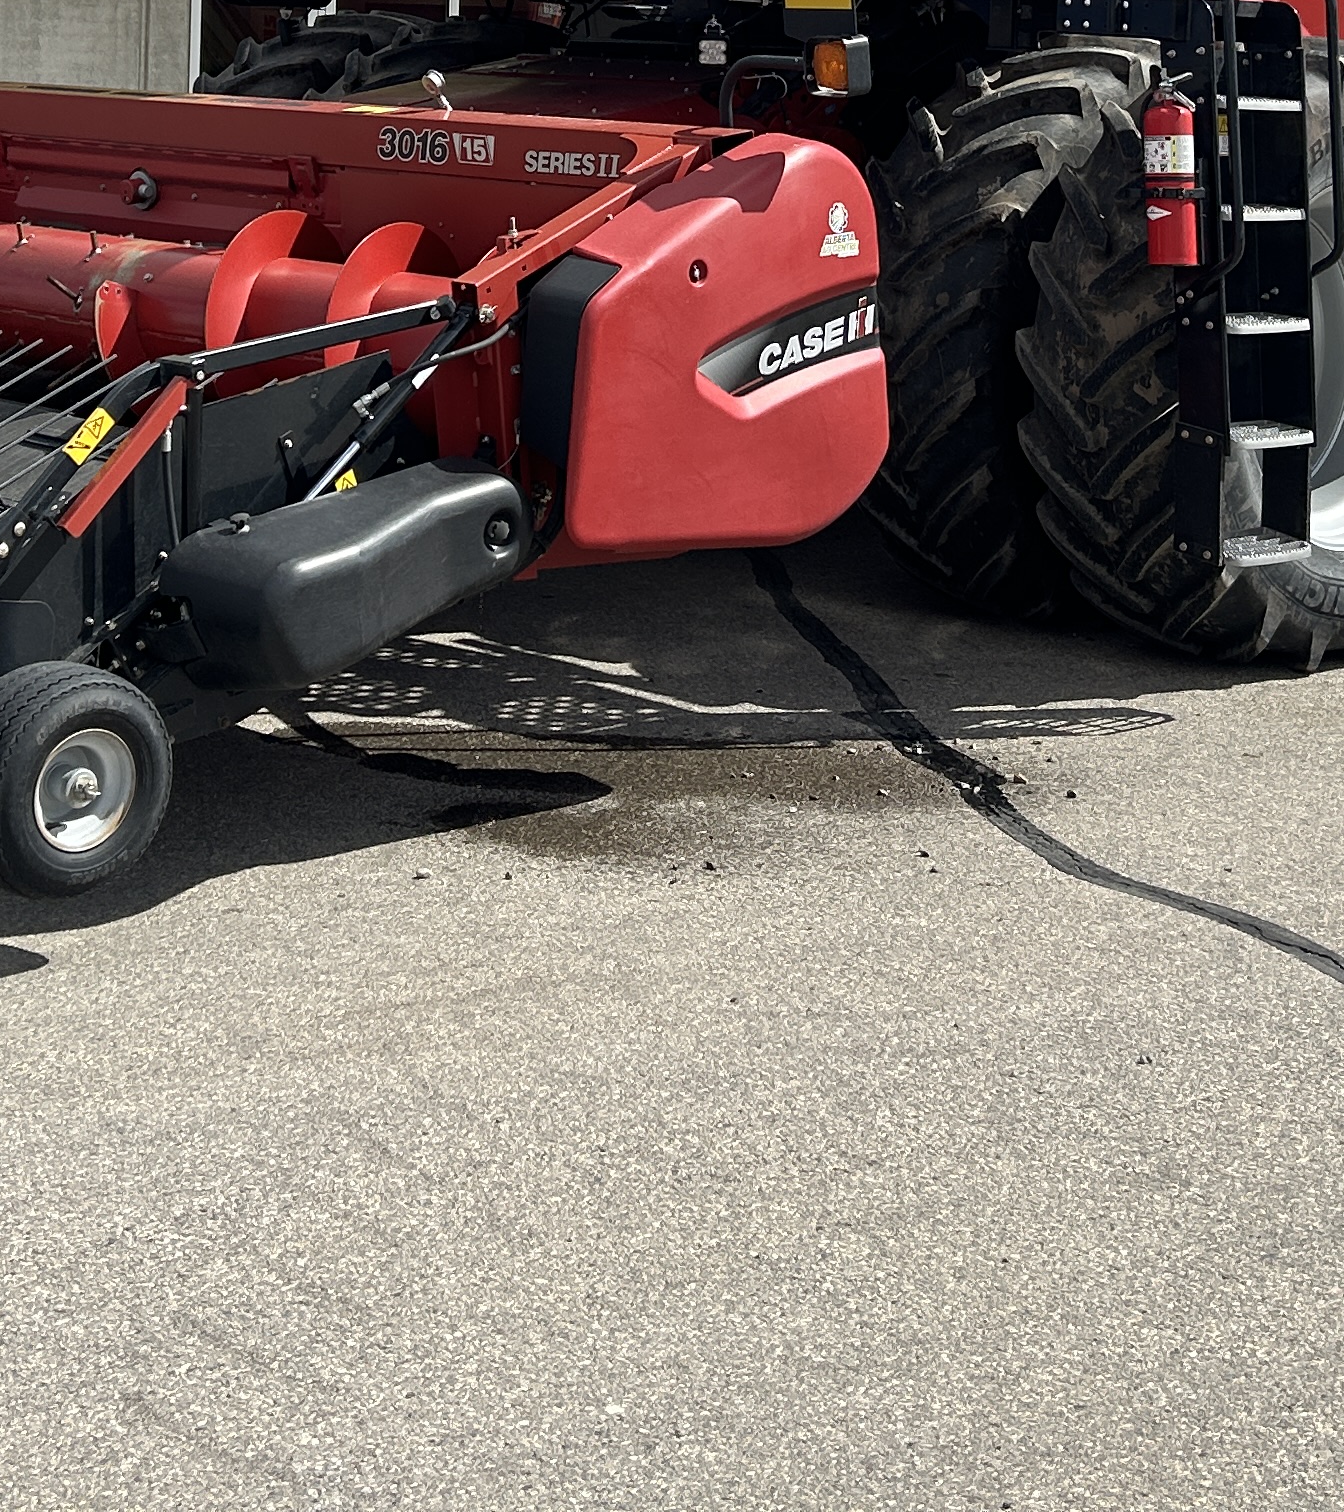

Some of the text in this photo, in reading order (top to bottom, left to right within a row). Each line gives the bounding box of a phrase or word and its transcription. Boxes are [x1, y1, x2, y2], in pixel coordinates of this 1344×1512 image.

[377, 125, 621, 178] 3016 15 SERIES II
[758, 315, 846, 376] CASE
